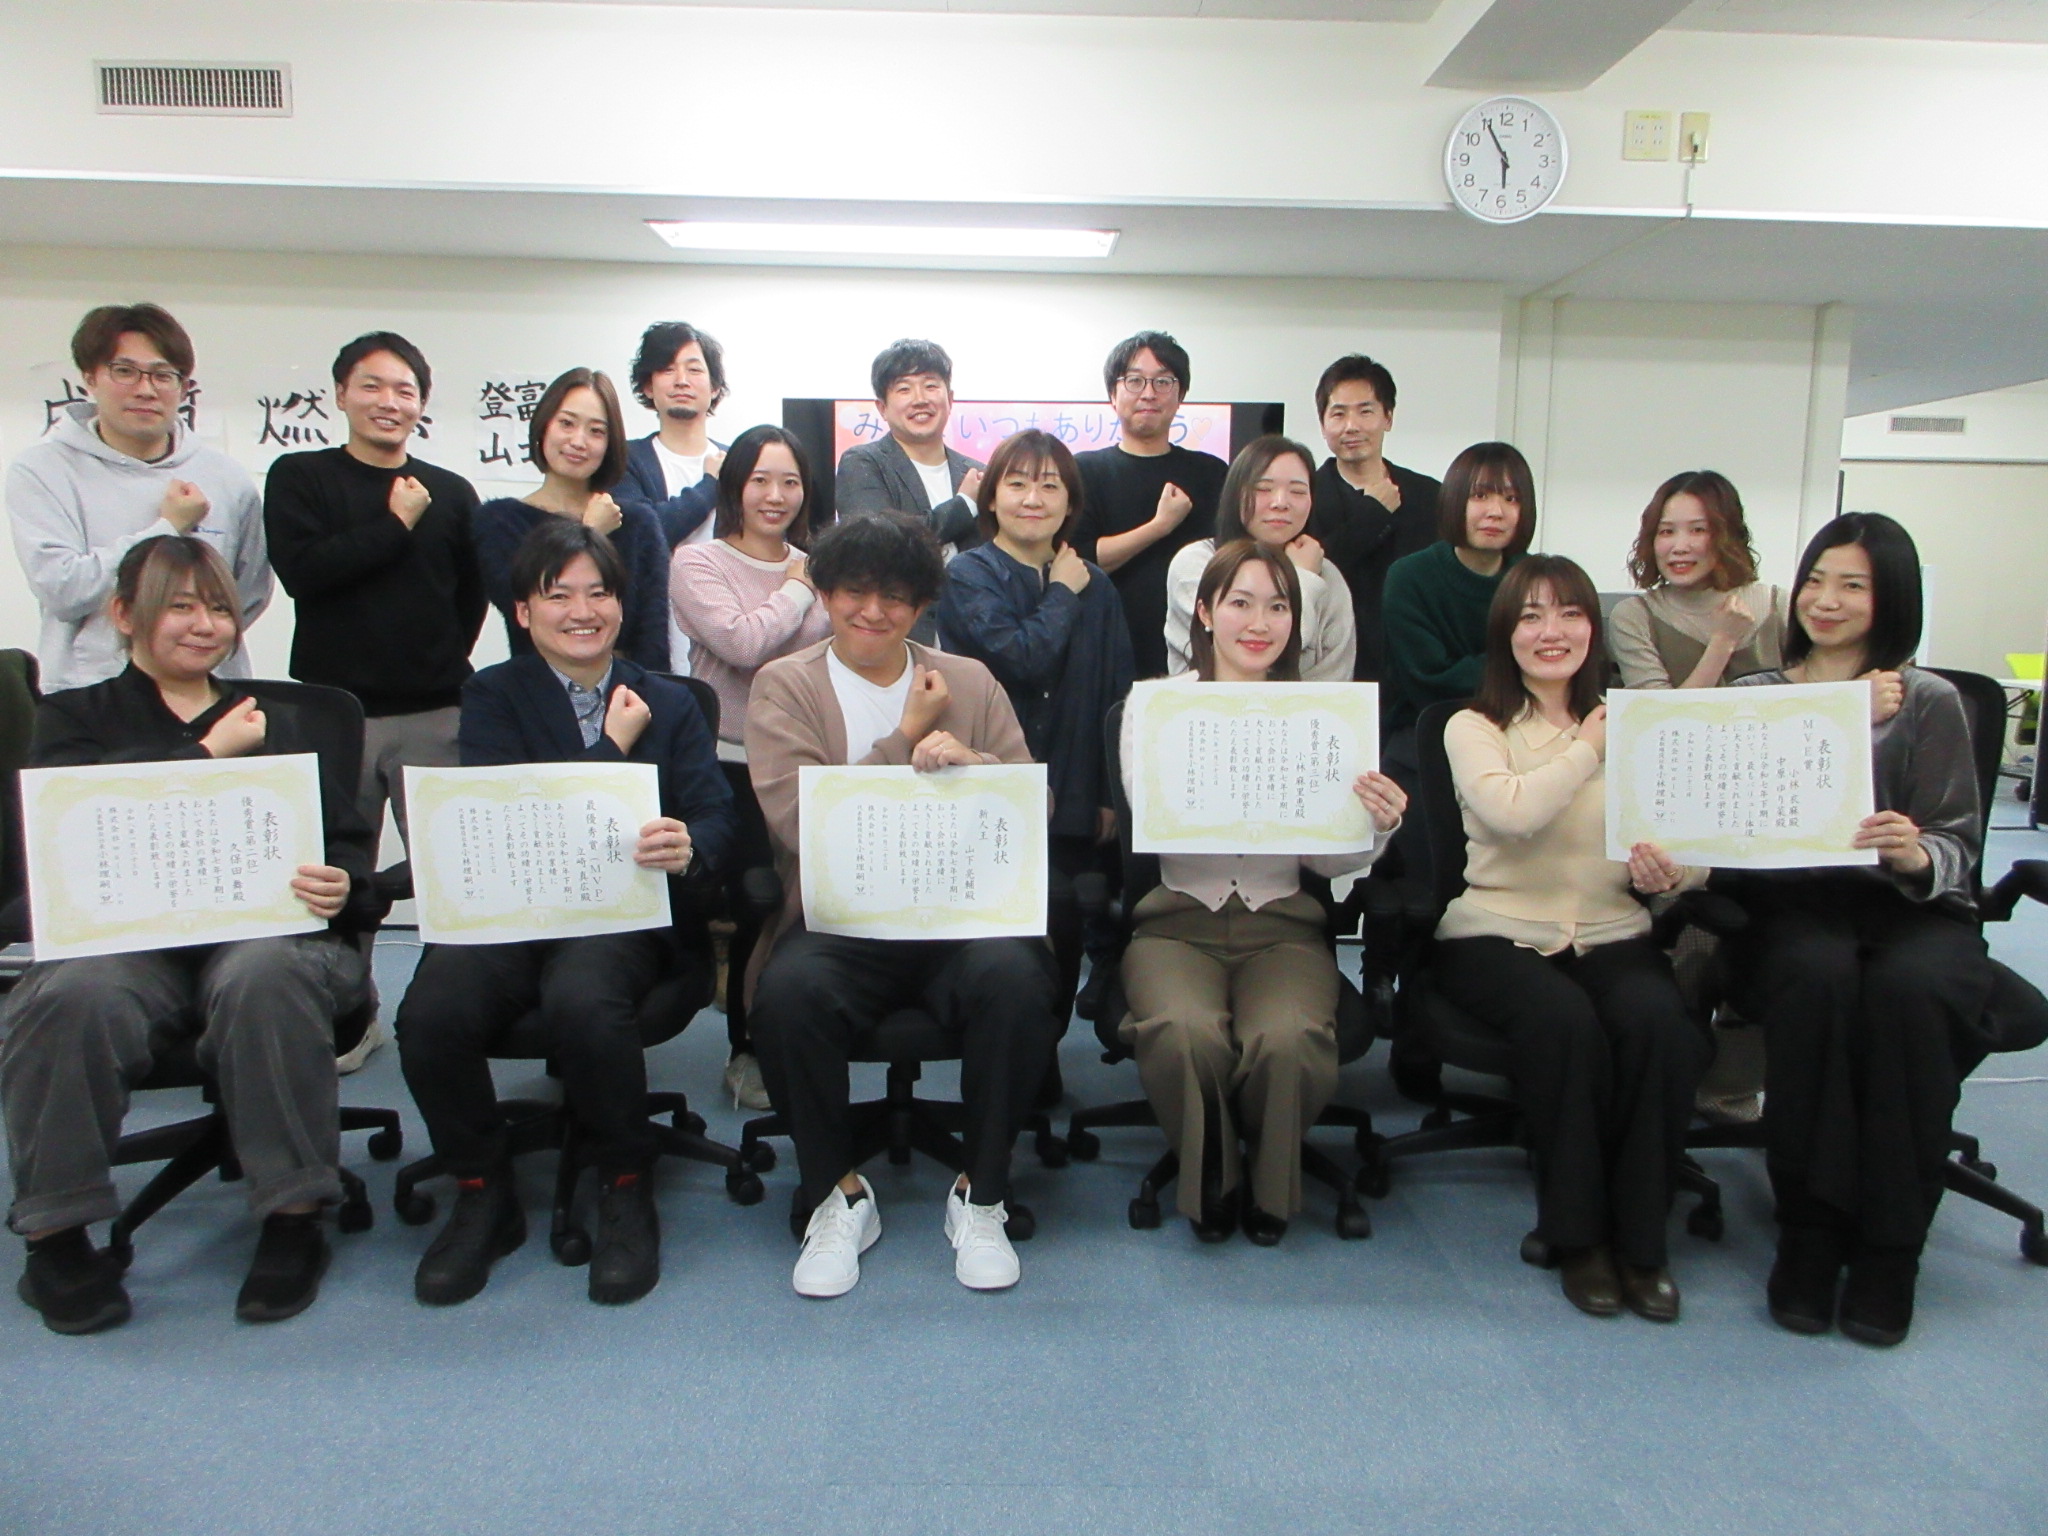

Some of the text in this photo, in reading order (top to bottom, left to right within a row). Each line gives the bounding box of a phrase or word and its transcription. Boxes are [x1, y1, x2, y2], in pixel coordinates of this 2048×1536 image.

[1482, 118, 1493, 131] 11
[1500, 112, 1514, 127] 12
[1523, 118, 1528, 132] 1
[1466, 132, 1480, 146] 10
[1533, 133, 1544, 147] 2
[1459, 153, 1470, 166] 9
[1538, 155, 1549, 168] 3
[1463, 173, 1475, 187] 8
[1530, 175, 1541, 188] 4
[1478, 188, 1488, 202] 7
[1495, 195, 1507, 208] 6
[1516, 189, 1527, 203] 5
[1325, 734, 1340, 782] 表彰状
[1816, 739, 1832, 789] 表彰状
[979, 809, 989, 840] 新人王
[262, 811, 282, 860] 表彰状
[604, 817, 624, 863] 表彰状
[994, 817, 1009, 864] 表彰状
